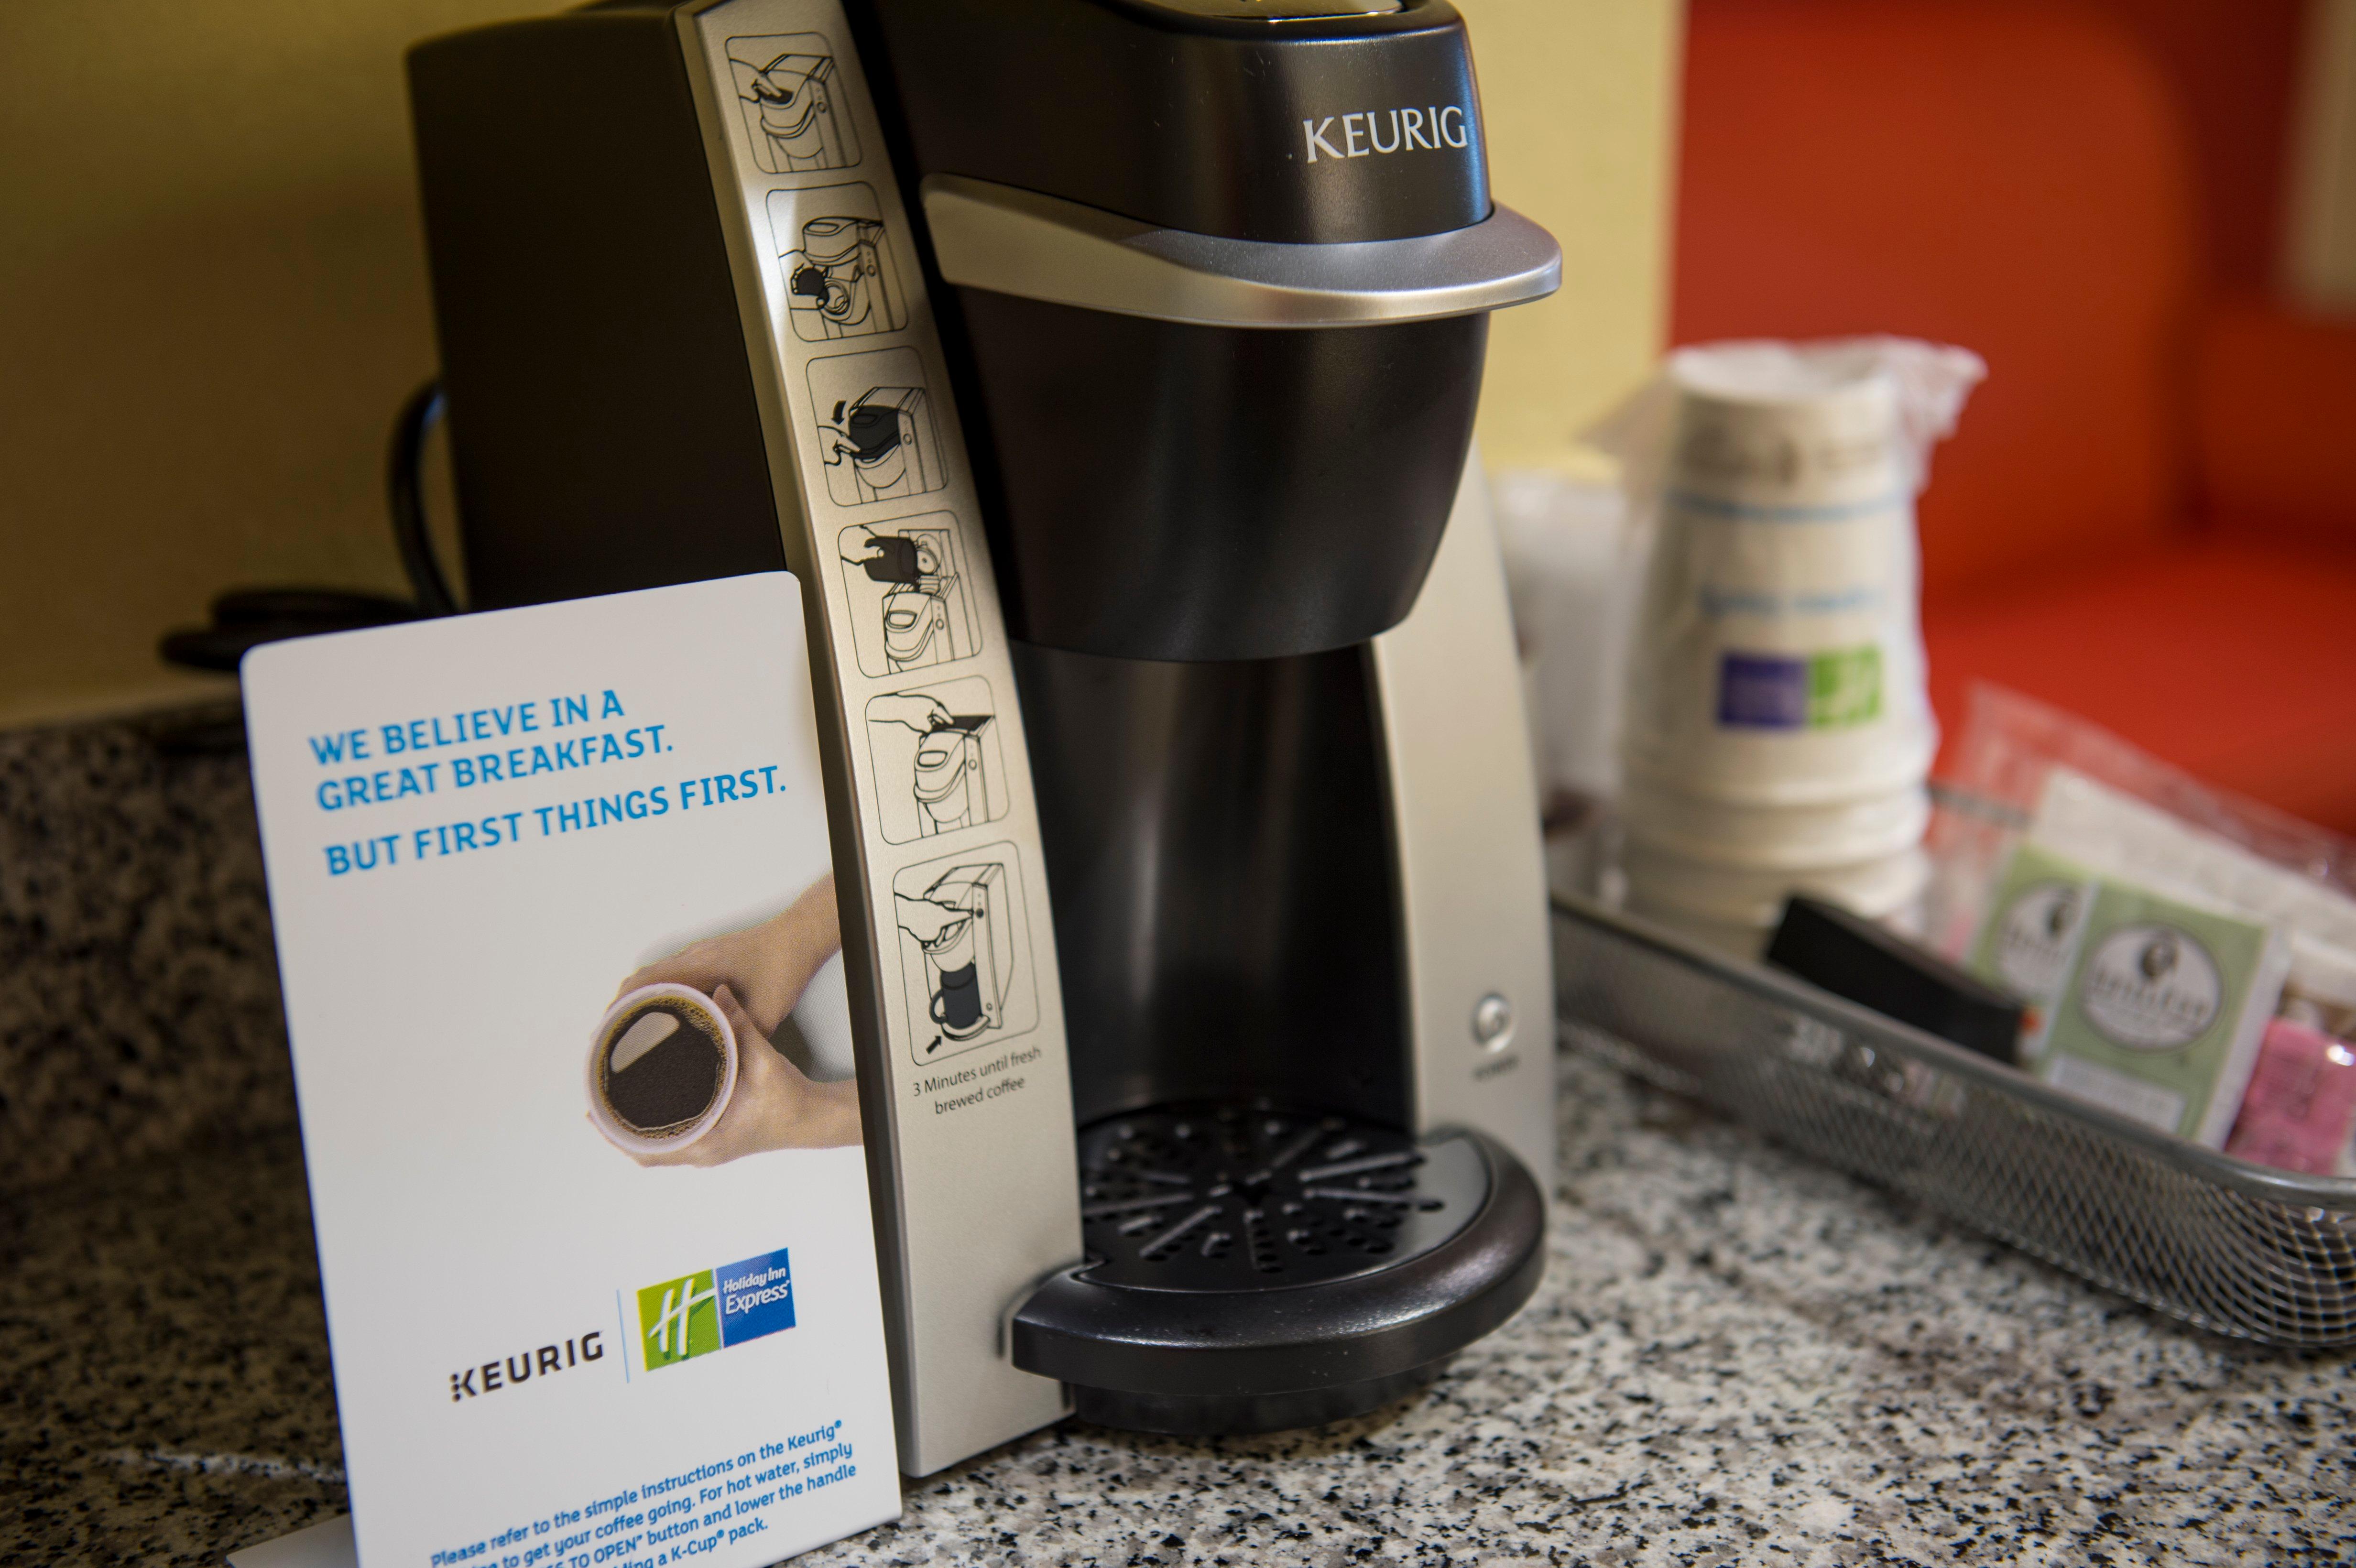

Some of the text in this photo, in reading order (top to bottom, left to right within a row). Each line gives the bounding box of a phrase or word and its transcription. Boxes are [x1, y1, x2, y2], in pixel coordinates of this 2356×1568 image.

[1303, 105, 1468, 163] KEURIG
[309, 690, 624, 766] WE BELIEVE IN A
[317, 724, 673, 811] GREAT BREAKFAST.
[326, 765, 786, 876] BUT FIRST THINGS FIRST.
[913, 1045, 1041, 1097] 3 Minutes until fresh
[935, 1077, 1025, 1114] brewed coffee
[723, 1267, 786, 1294] Holiday Inn
[725, 1280, 790, 1315] Express
[450, 1331, 604, 1403] KEURIG
[431, 1541, 487, 1568] Please
[491, 1527, 528, 1547] refer
[534, 1520, 551, 1535] to
[555, 1510, 581, 1527] the
[586, 1491, 638, 1518] simple
[642, 1459, 734, 1498] instructions
[738, 1452, 756, 1467] on
[760, 1443, 784, 1459] the
[503, 1443, 852, 1568] to get your coffee going. For hot water, simply
[569, 1553, 590, 1568] TO
[647, 1518, 699, 1545] button
[704, 1503, 732, 1526] and
[735, 1492, 775, 1514] lower
[779, 1483, 803, 1500] the
[807, 1464, 856, 1491] handle
[659, 1553, 668, 1565] a
[729, 1517, 768, 1545] pack.
